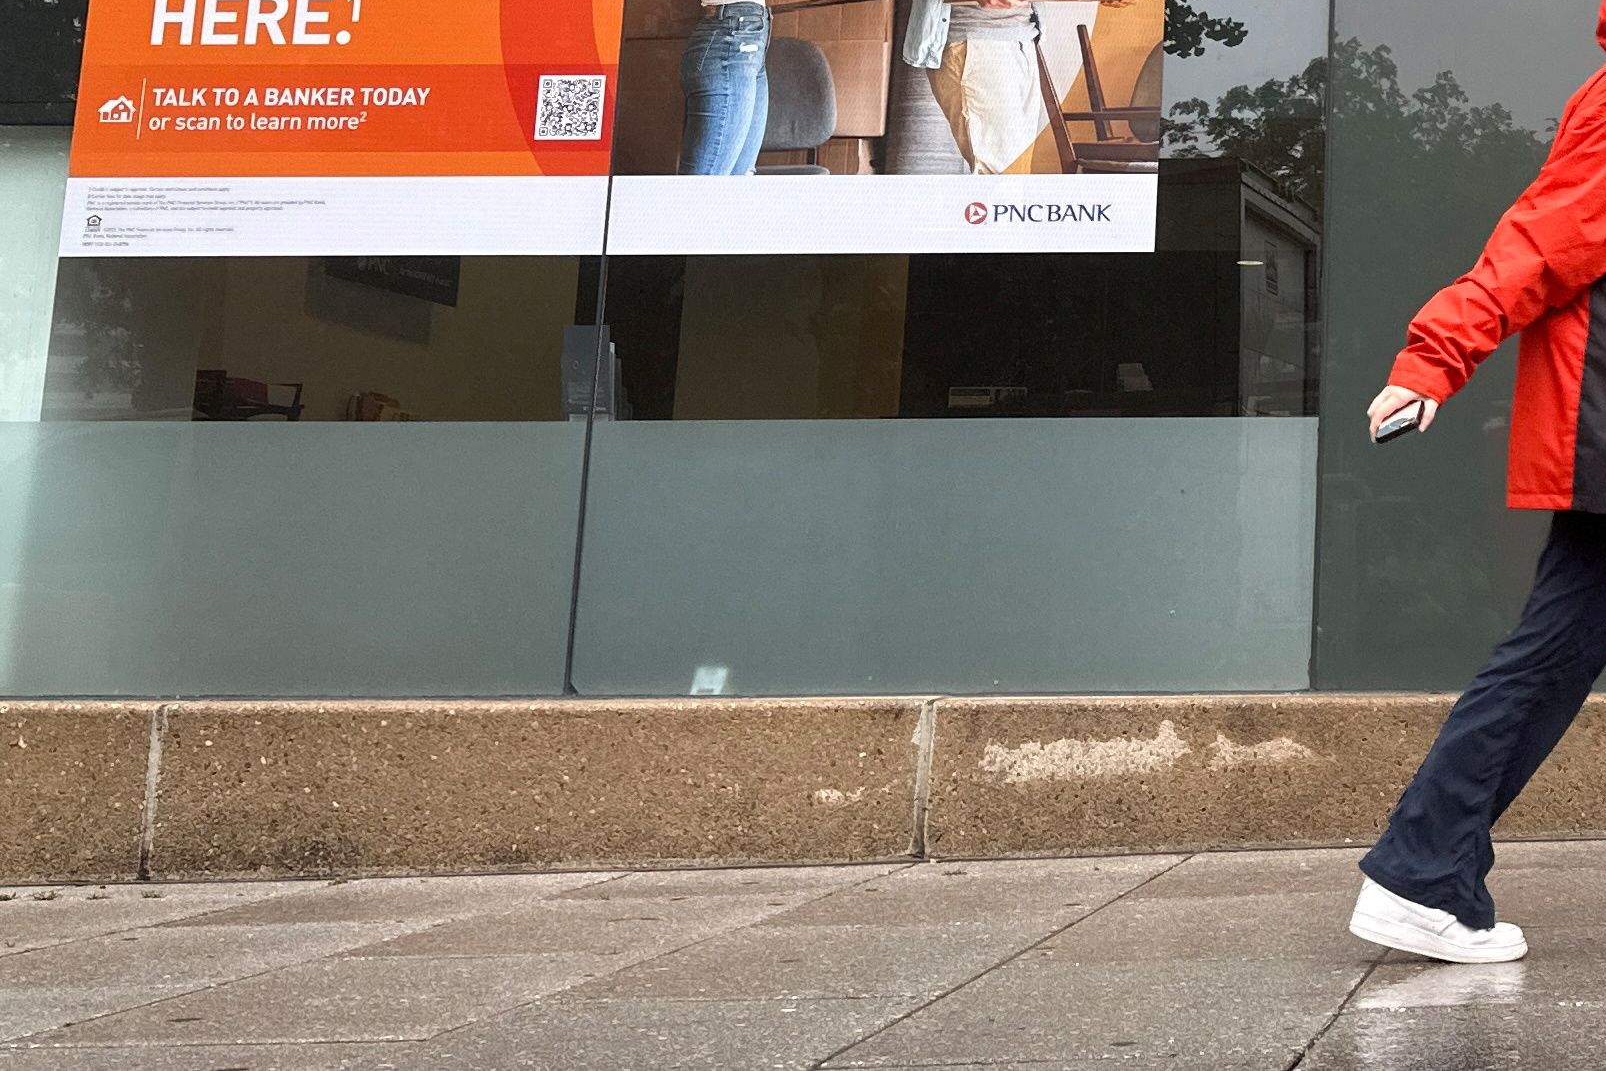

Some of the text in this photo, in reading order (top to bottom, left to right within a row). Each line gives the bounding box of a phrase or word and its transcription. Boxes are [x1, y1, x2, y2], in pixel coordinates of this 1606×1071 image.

[152, 87, 431, 107] TALK TO A BANKER TODAY
[148, 115, 171, 131] or
[175, 116, 220, 130] scan
[226, 113, 245, 130] to
[250, 112, 302, 130] learn
